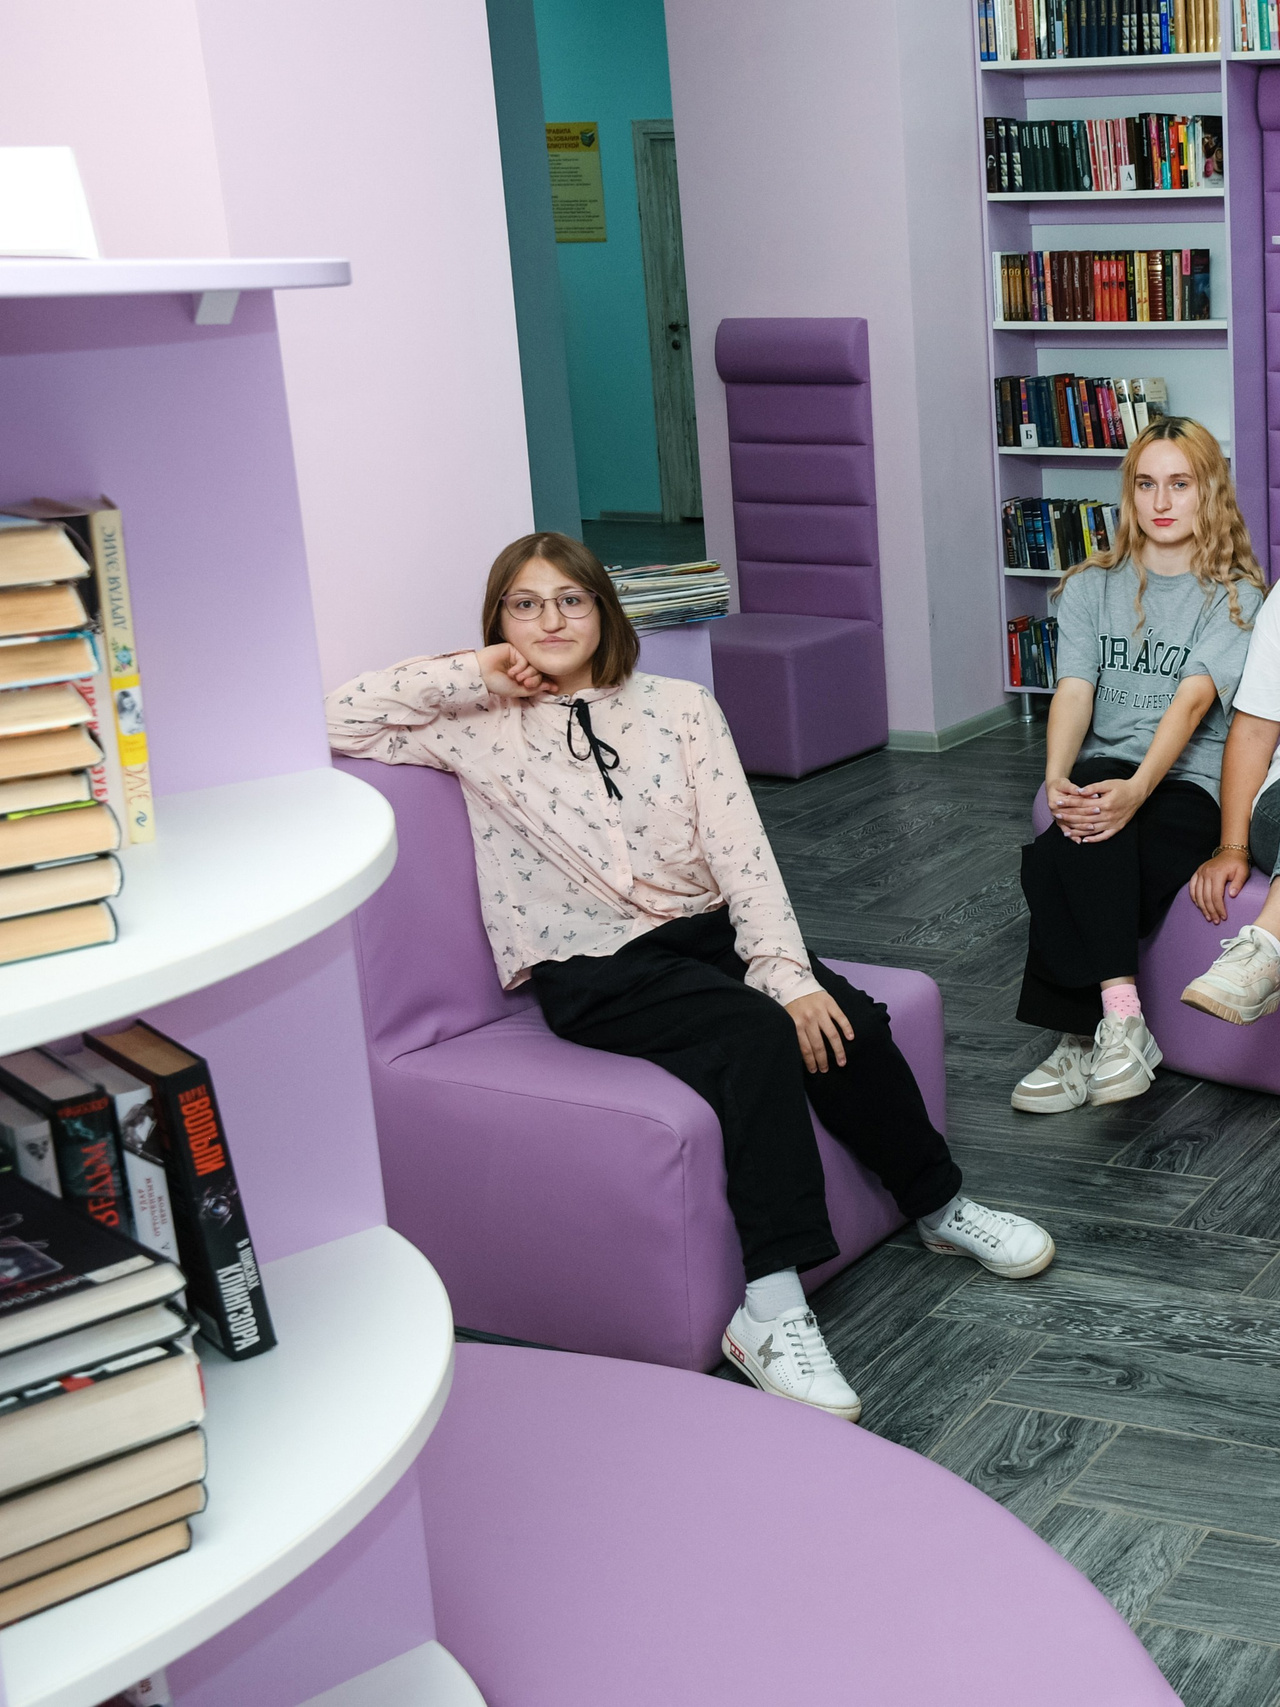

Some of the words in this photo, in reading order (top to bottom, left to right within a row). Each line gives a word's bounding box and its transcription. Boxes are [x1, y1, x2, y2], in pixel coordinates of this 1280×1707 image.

[1125, 172, 1133, 182] А
[1025, 430, 1033, 440] Б
[101, 526, 120, 572] ЭЛИС
[107, 576, 128, 630] ДРУГАЯ
[181, 1096, 226, 1177] ВОЛЬПИ
[236, 1237, 249, 1249] В
[239, 1246, 260, 1291] ПОИСКАХ
[216, 1262, 260, 1352] КЛИНГЗОРА
